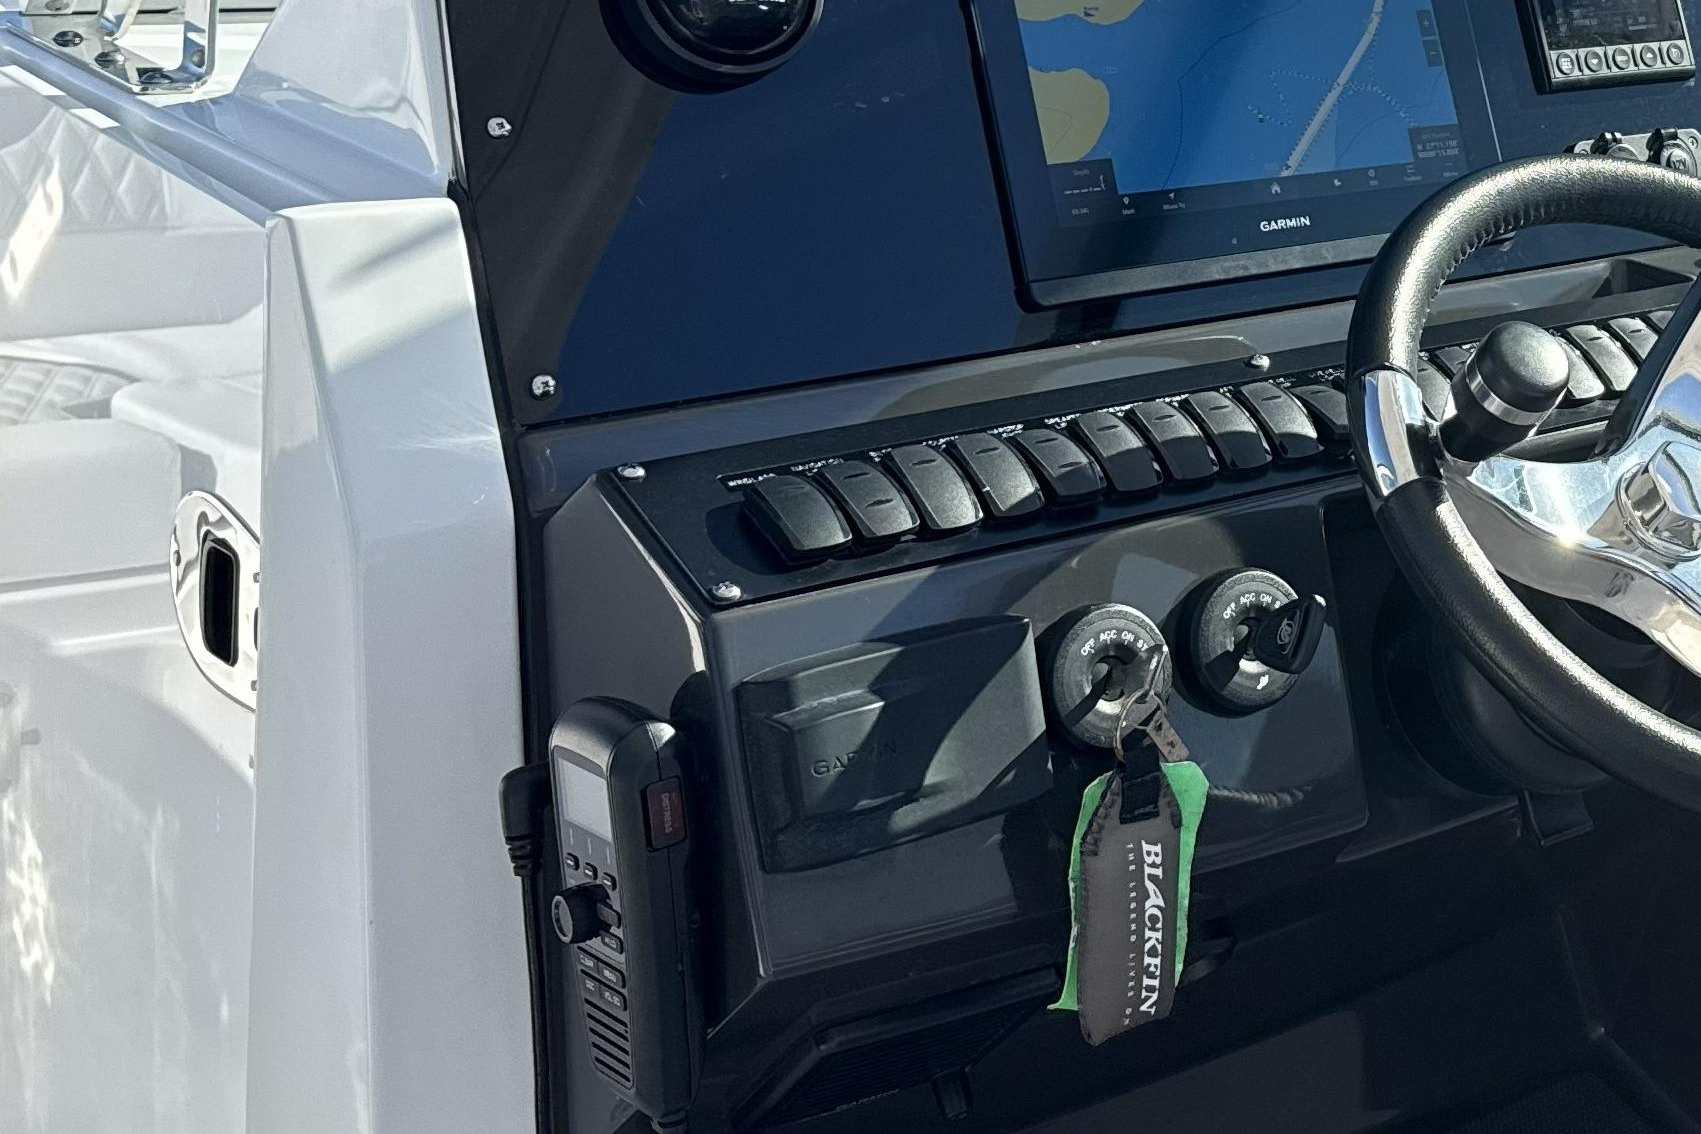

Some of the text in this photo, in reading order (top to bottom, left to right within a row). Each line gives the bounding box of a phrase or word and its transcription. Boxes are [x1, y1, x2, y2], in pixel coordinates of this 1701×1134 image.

[1259, 215, 1311, 232] GARMIN
[1260, 593, 1272, 604] ON
[1100, 630, 1117, 642] ACC
[1121, 631, 1135, 642] ON
[1126, 843, 1136, 871] THE
[1139, 839, 1166, 1015] BLACKFIN
